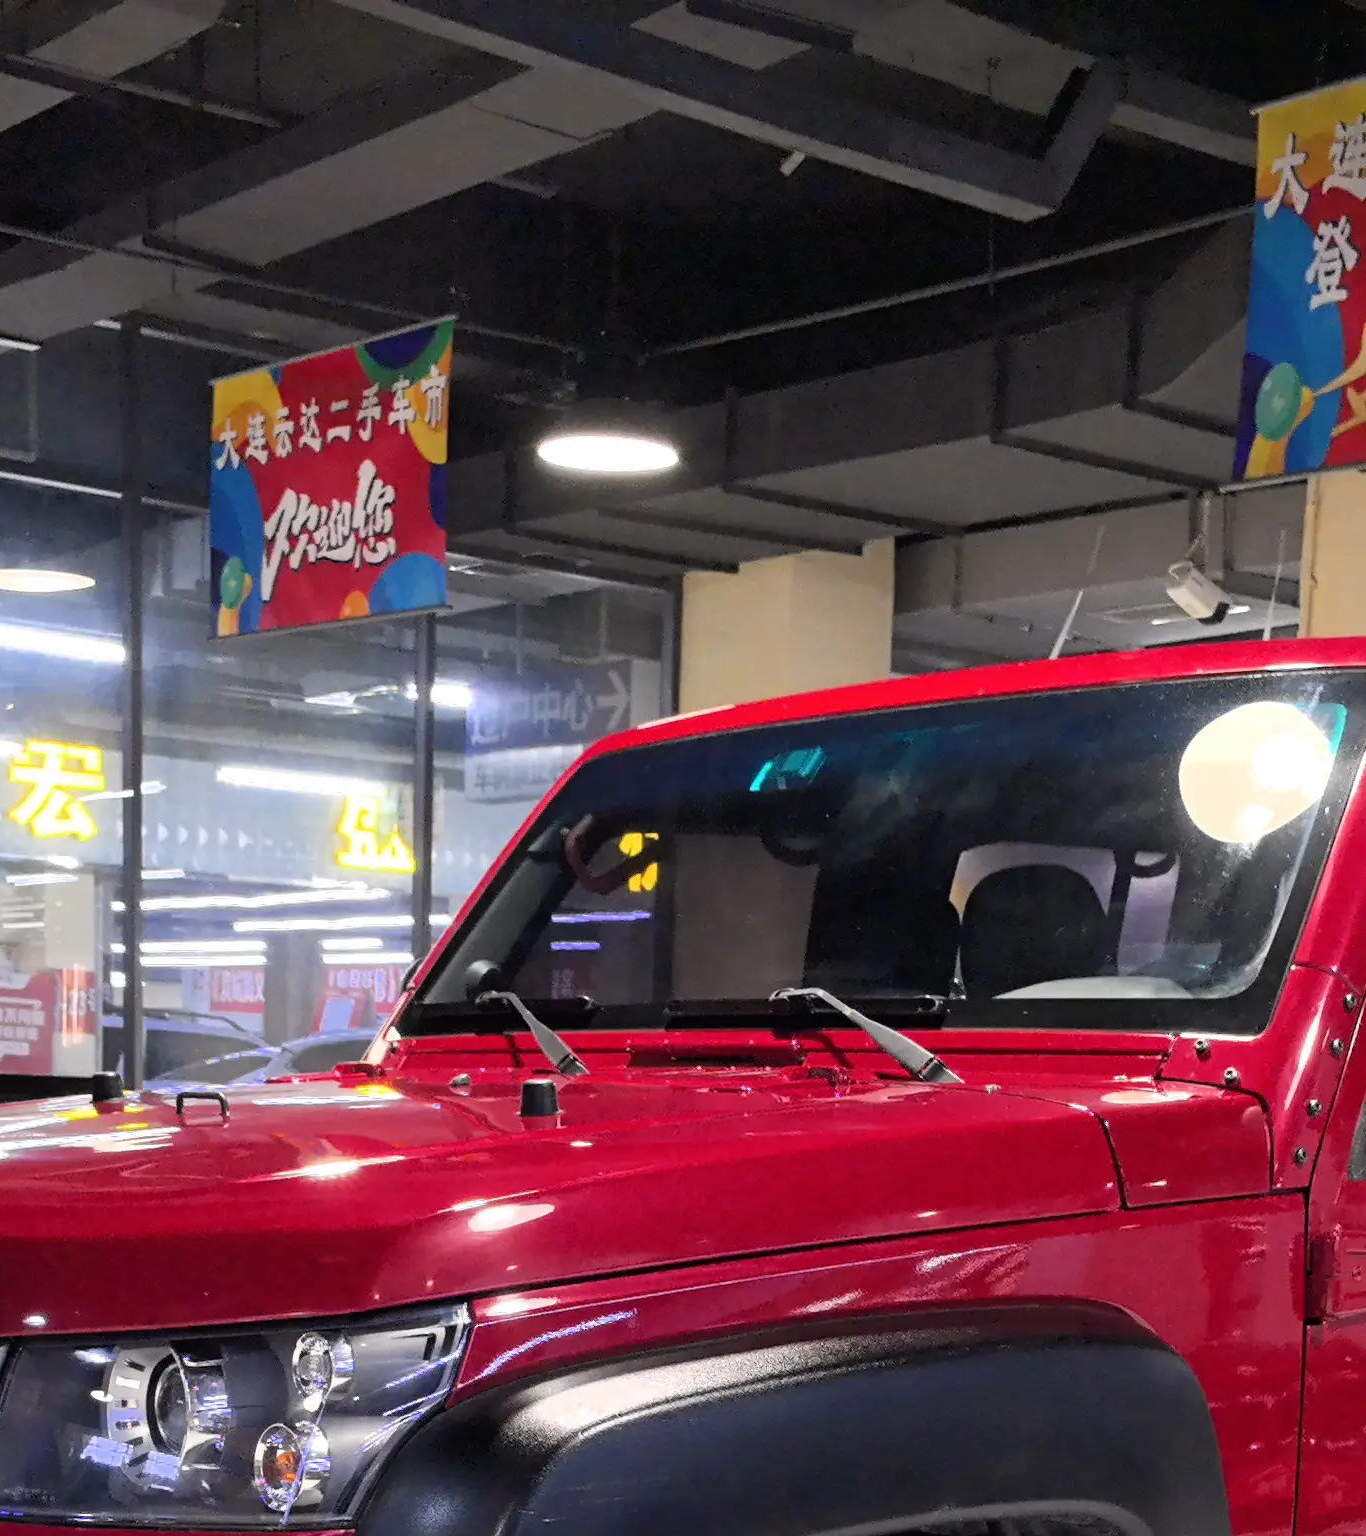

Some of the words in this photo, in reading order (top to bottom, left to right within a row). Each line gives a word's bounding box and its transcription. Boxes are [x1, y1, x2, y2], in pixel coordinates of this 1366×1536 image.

[215, 365, 449, 471] 大连云达二手车市
[261, 459, 398, 603] 欢迎您
